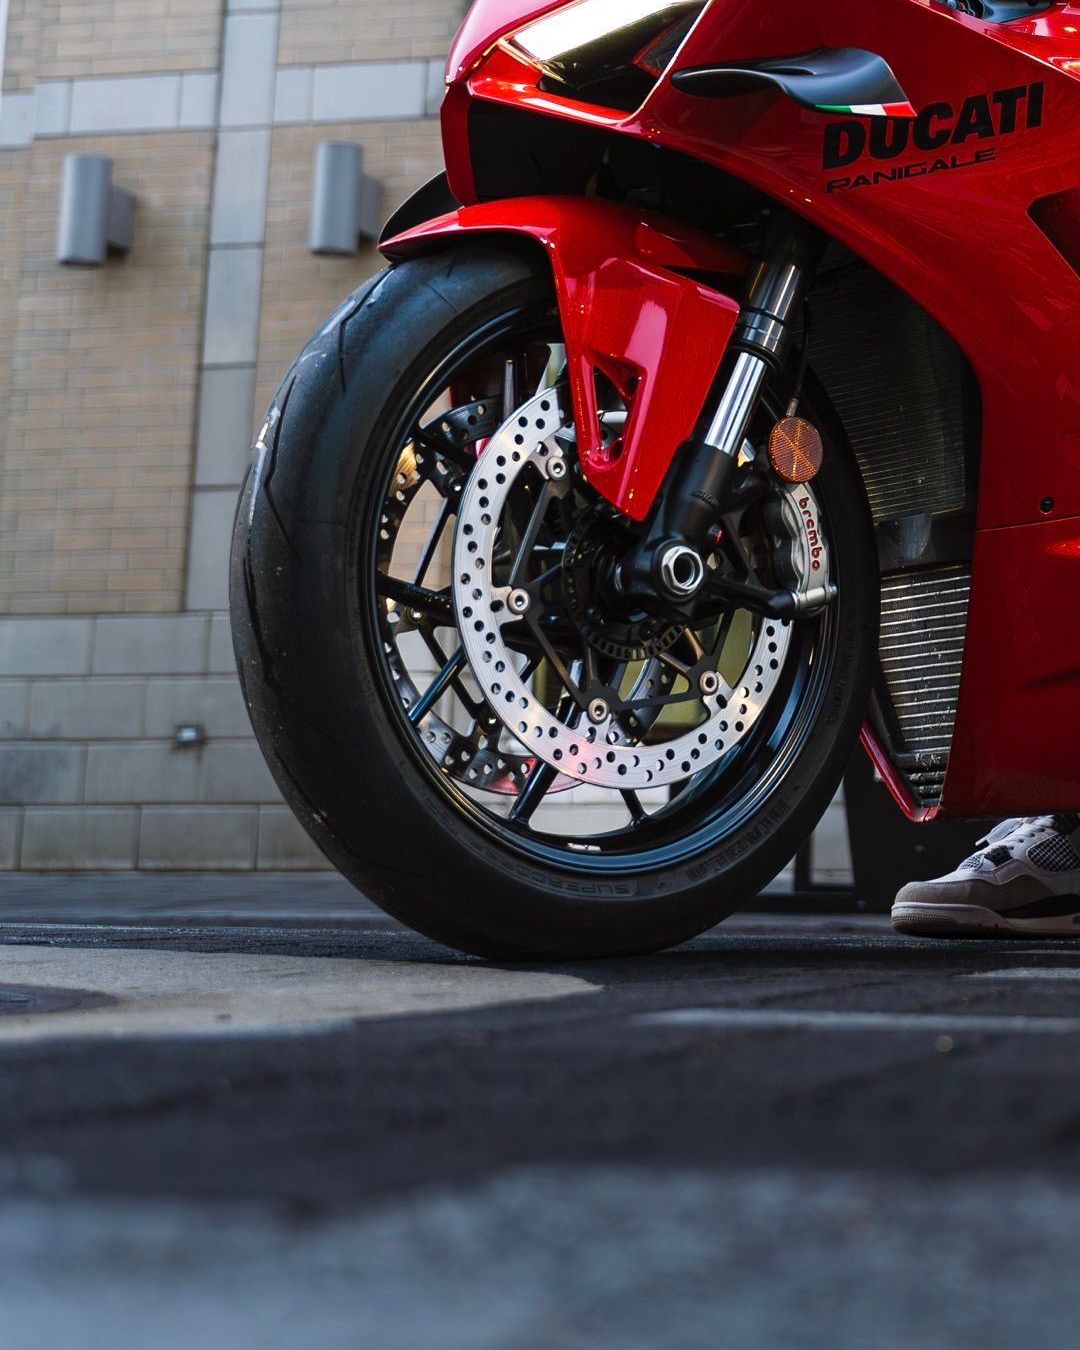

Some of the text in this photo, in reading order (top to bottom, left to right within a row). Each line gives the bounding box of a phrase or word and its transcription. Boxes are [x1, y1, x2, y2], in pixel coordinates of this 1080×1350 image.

[822, 81, 1044, 170] DUCATI
[826, 147, 998, 194] PANIGALE
[798, 496, 823, 571] brembo
